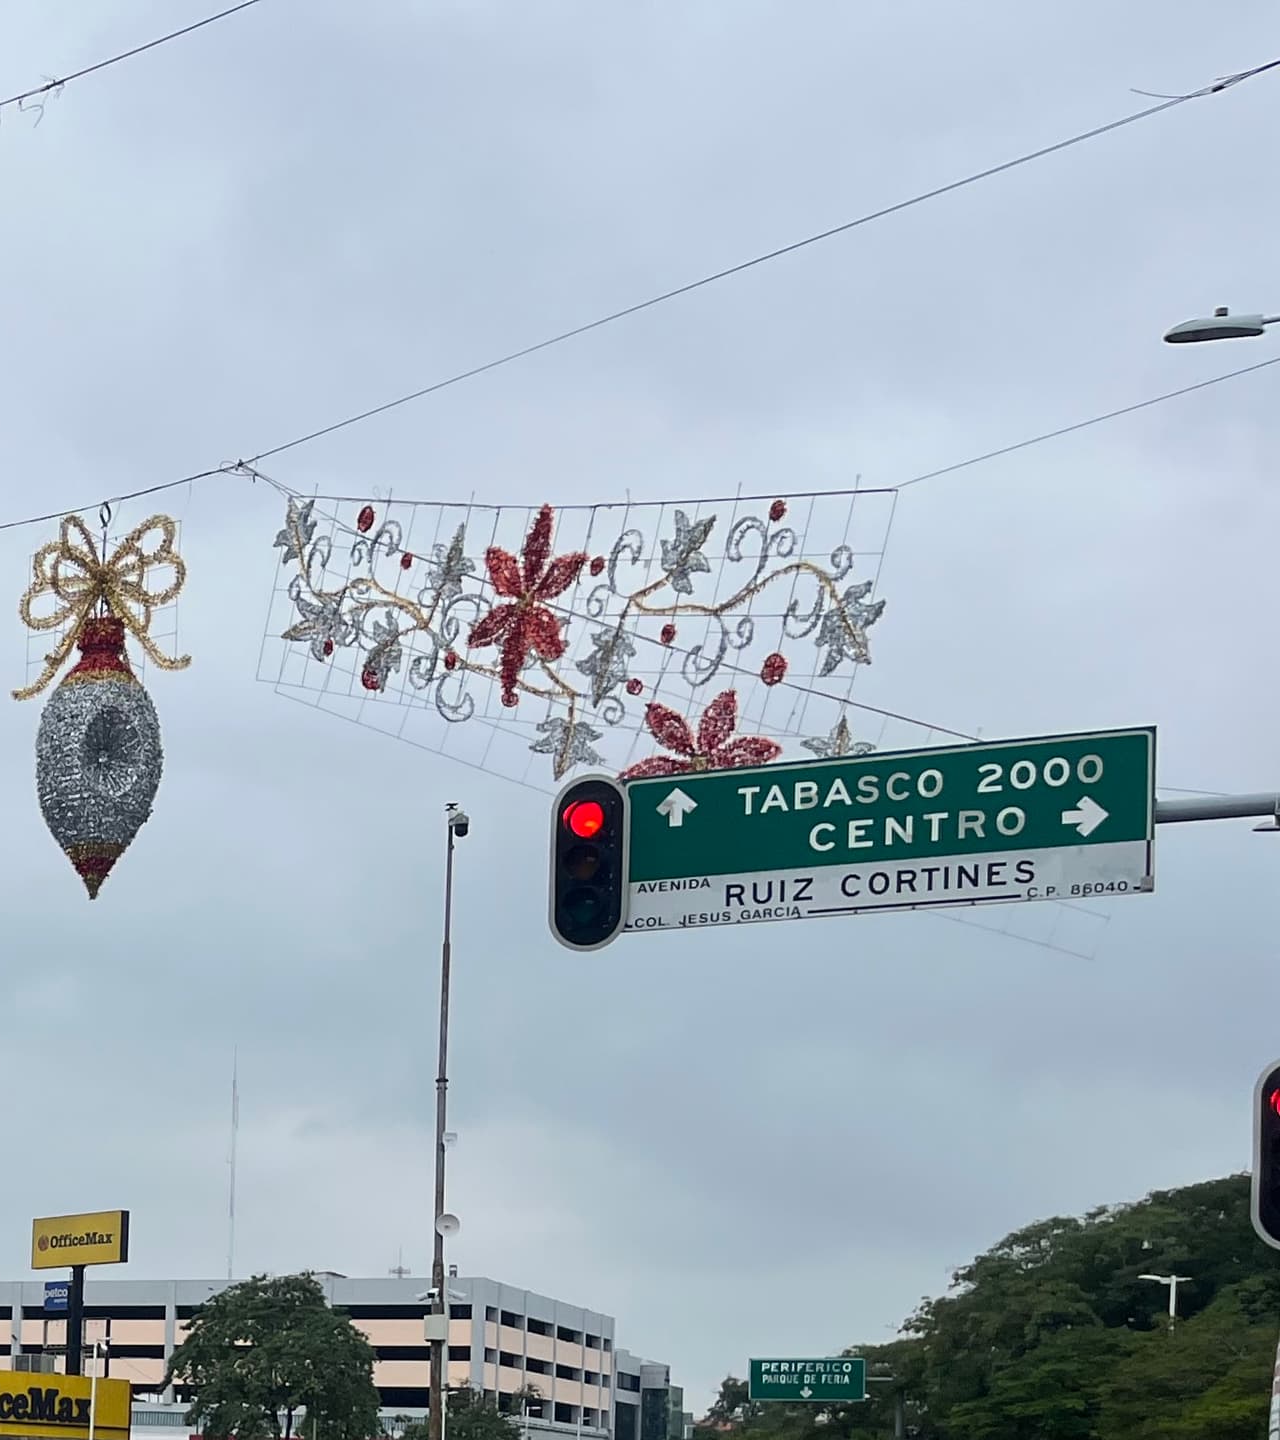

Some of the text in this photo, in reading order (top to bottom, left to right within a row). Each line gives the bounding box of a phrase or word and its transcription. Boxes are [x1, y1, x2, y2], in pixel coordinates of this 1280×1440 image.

[738, 754, 1104, 817] TABASCO 2000
[809, 806, 1027, 852] CENTRO
[637, 878, 711, 894] AVENIDA
[726, 860, 1036, 907] RUIZ CORTINES
[1027, 887, 1060, 899] C.P.
[679, 911, 732, 926] JESUS
[741, 906, 801, 920] GARCIA
[50, 1232, 113, 1248] OfficeMax
[761, 1362, 852, 1373] PERIFERICO
[762, 1374, 850, 1384] PARQUE DE FERIA
